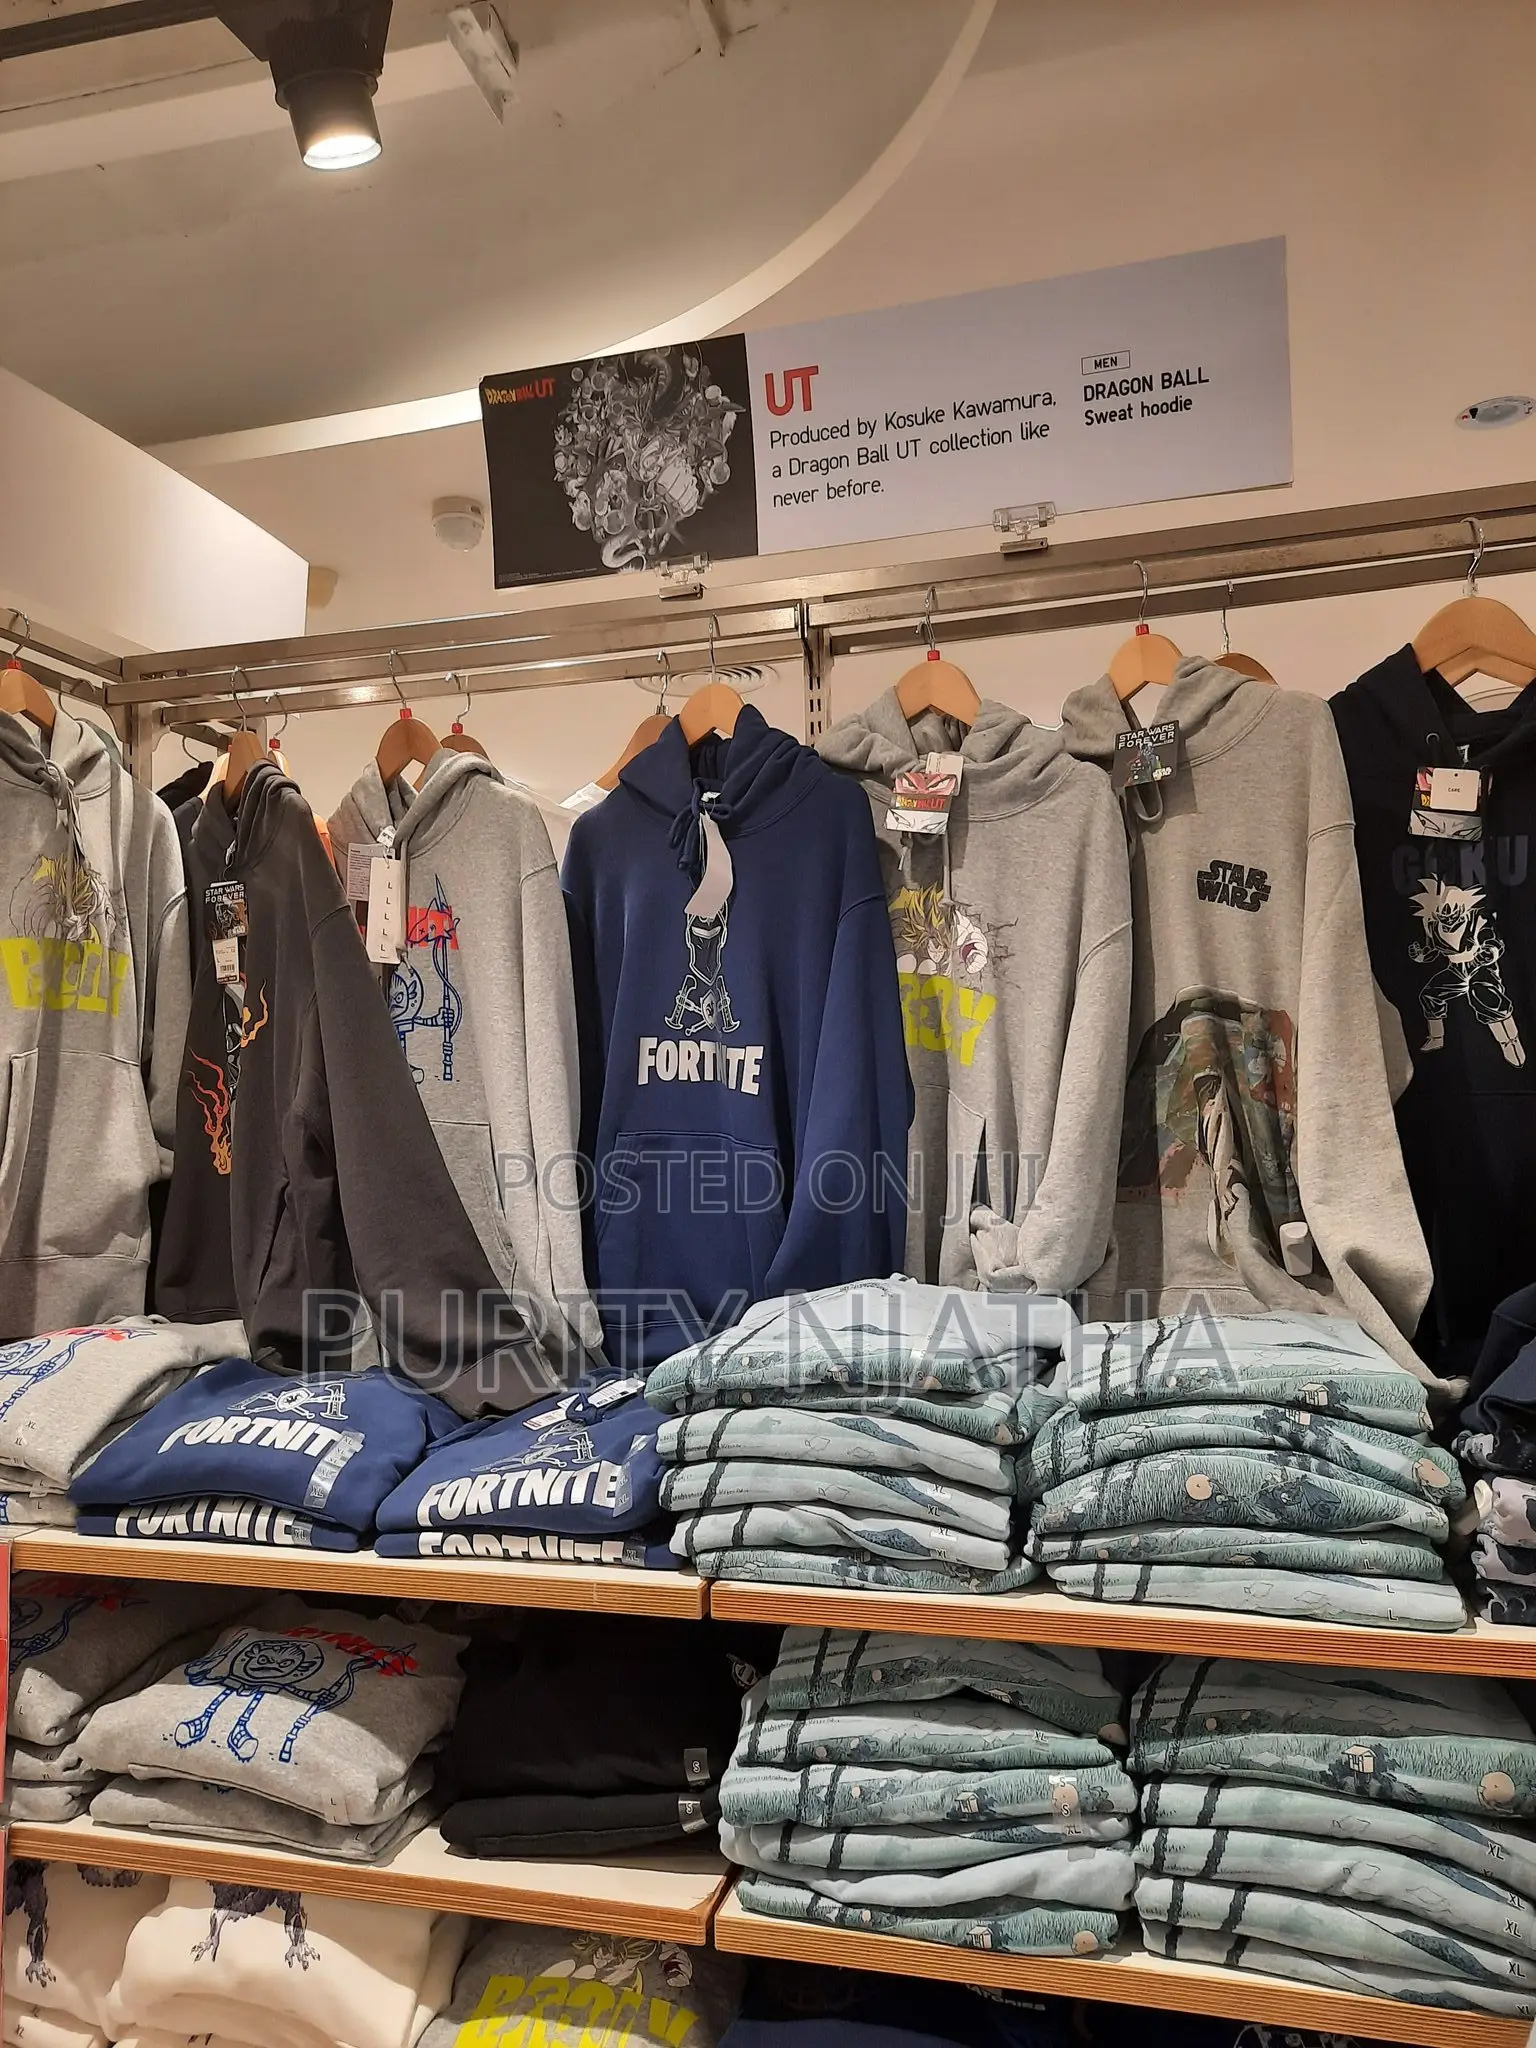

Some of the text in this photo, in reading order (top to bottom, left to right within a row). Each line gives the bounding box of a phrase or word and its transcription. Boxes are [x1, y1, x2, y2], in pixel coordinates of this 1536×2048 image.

[1094, 356, 1118, 369] MEN
[535, 378, 554, 398] UT
[765, 365, 819, 416] UT
[1083, 367, 1210, 402] DRAGON BALL
[1084, 395, 1193, 426] Sweat hoodie
[769, 391, 1057, 449] Produced by Kosuke Kawamura,
[771, 420, 1050, 478] a Dragon Ball UT collection like
[773, 479, 884, 508] never before.
[1119, 730, 1145, 743] STAR
[1146, 723, 1175, 736] WARS
[1118, 731, 1175, 750] FOREVER
[1197, 860, 1272, 894] STAR
[204, 883, 245, 898] STAR WARS
[1197, 878, 1270, 913] WARS
[205, 891, 245, 905] FOREVER
[917, 1371, 924, 1381] S
[26, 1420, 37, 1430] XL
[14, 1437, 23, 1446] XL
[310, 1485, 324, 1498] XL
[417, 1460, 624, 1528] FORTNITE
[933, 1483, 946, 1494] XL
[37, 1501, 42, 1510] L
[928, 1504, 941, 1517] XL
[293, 1527, 307, 1541] XL
[938, 1527, 951, 1537] XL
[1359, 1537, 1368, 1545] L
[626, 1549, 638, 1559] XL
[936, 1549, 948, 1559] XL
[1365, 1559, 1375, 1570] L
[1386, 1584, 1395, 1594] L
[1389, 1609, 1398, 1621] L
[1035, 1730, 1048, 1741] XL
[692, 1760, 701, 1773] S
[1059, 1776, 1066, 1788] S
[330, 1797, 337, 1806] L
[685, 1802, 693, 1815] S
[1061, 1804, 1070, 1816] S
[1066, 1825, 1082, 1835] XL
[1487, 1843, 1505, 1861] XL
[1509, 1892, 1526, 1910] XL
[1505, 1918, 1522, 1938] XL
[1508, 1961, 1526, 1978] XL
